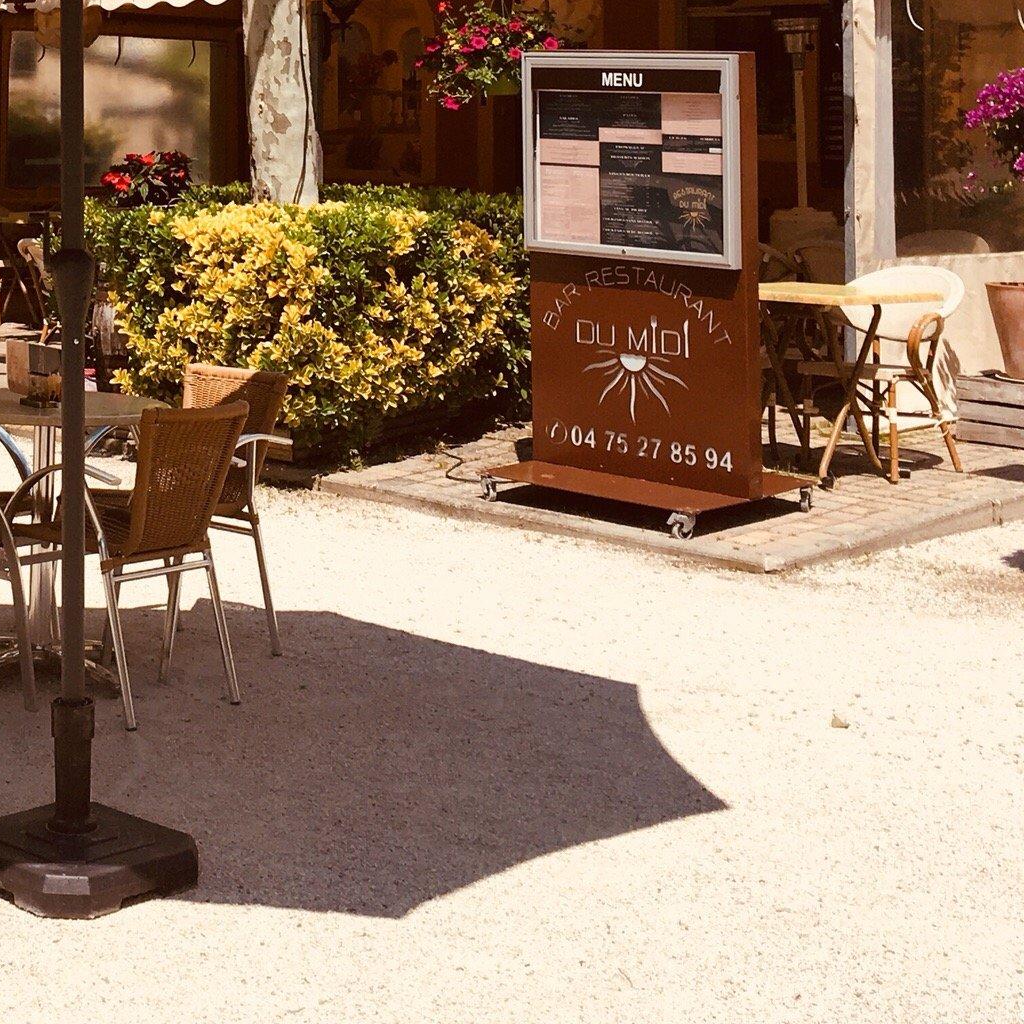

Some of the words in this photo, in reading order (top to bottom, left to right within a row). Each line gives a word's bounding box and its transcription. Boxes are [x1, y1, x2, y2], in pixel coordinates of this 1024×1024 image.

[601, 72, 643, 88] MENU
[543, 282, 581, 330] BAR
[585, 266, 732, 345] RESTAURANT
[576, 320, 616, 347] DU
[628, 315, 690, 358] MIDI
[570, 425, 596, 448] 04
[605, 431, 628, 454] 75
[637, 436, 661, 459] 27
[670, 442, 697, 466] 85
[705, 447, 734, 472] 94
